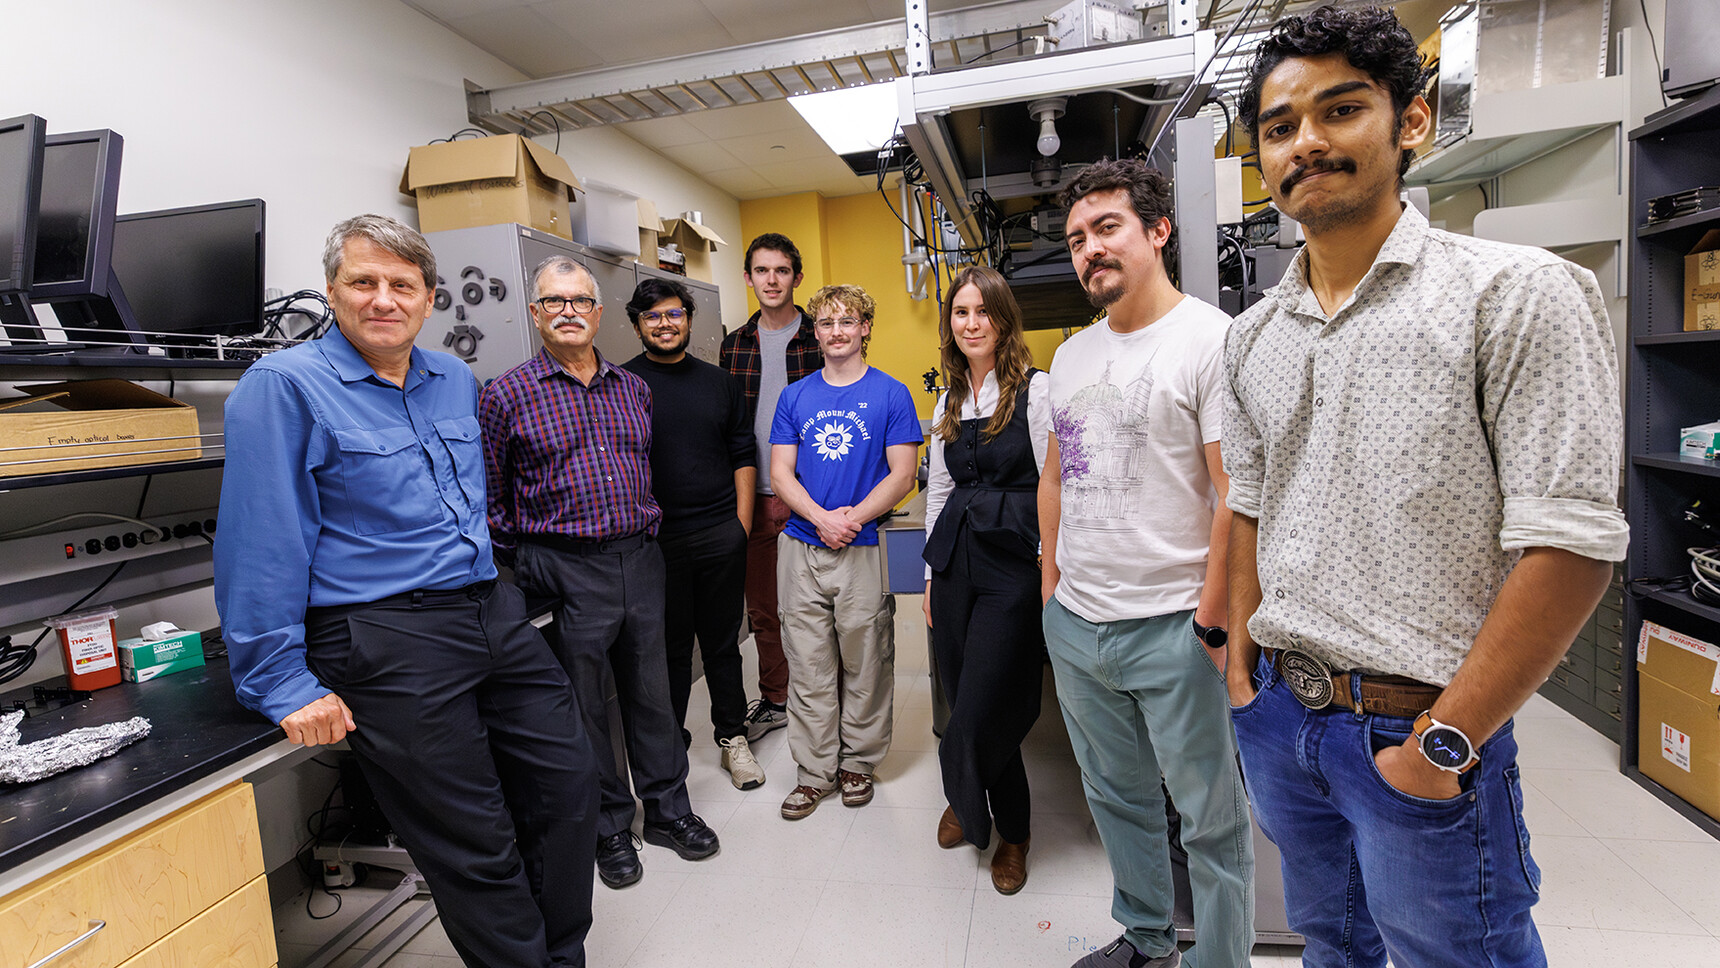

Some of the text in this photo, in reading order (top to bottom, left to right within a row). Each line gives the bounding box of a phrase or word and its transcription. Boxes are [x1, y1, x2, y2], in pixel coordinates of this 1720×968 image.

[799, 409, 871, 440] Camp Mount Michael
[47, 435, 80, 445] Empty
[84, 434, 109, 443] optical
[1668, 634, 1706, 653] DUNIWAY
